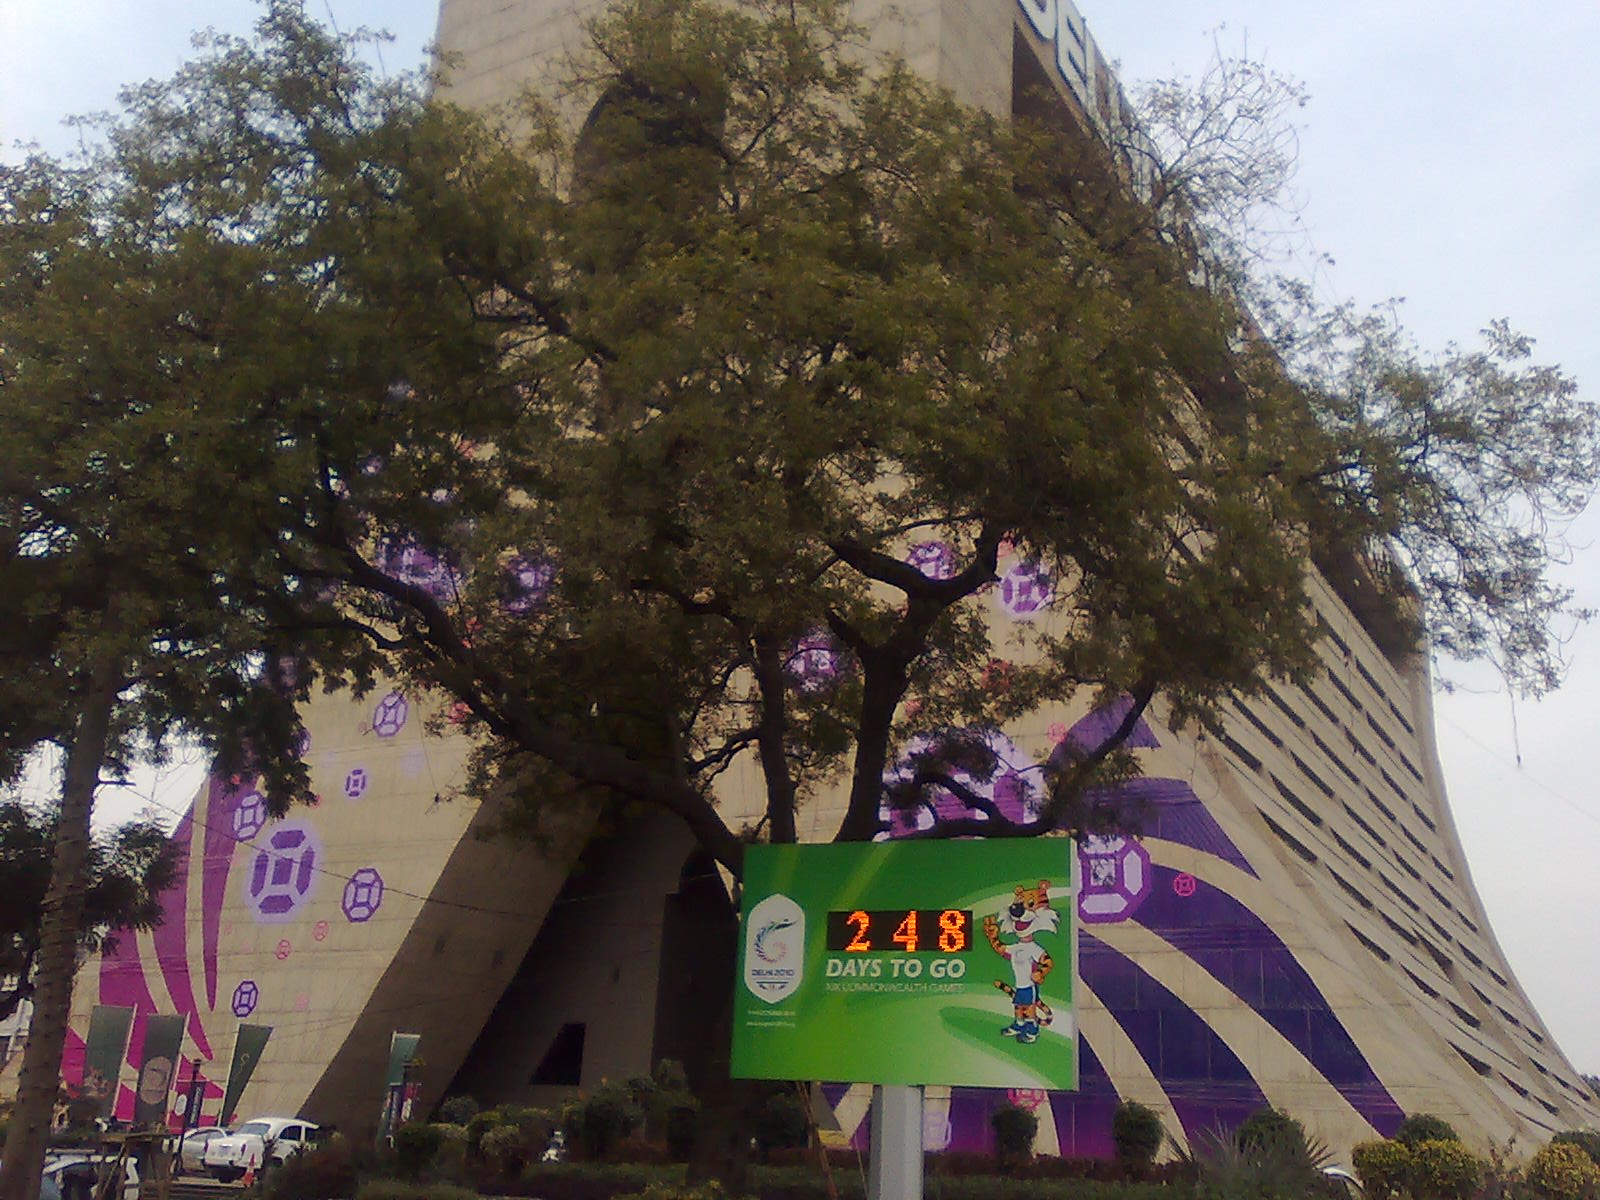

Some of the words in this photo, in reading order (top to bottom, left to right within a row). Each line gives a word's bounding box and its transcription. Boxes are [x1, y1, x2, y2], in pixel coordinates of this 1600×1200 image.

[825, 959, 882, 978] DAYS
[890, 959, 923, 978] TO
[929, 959, 966, 979] GO
